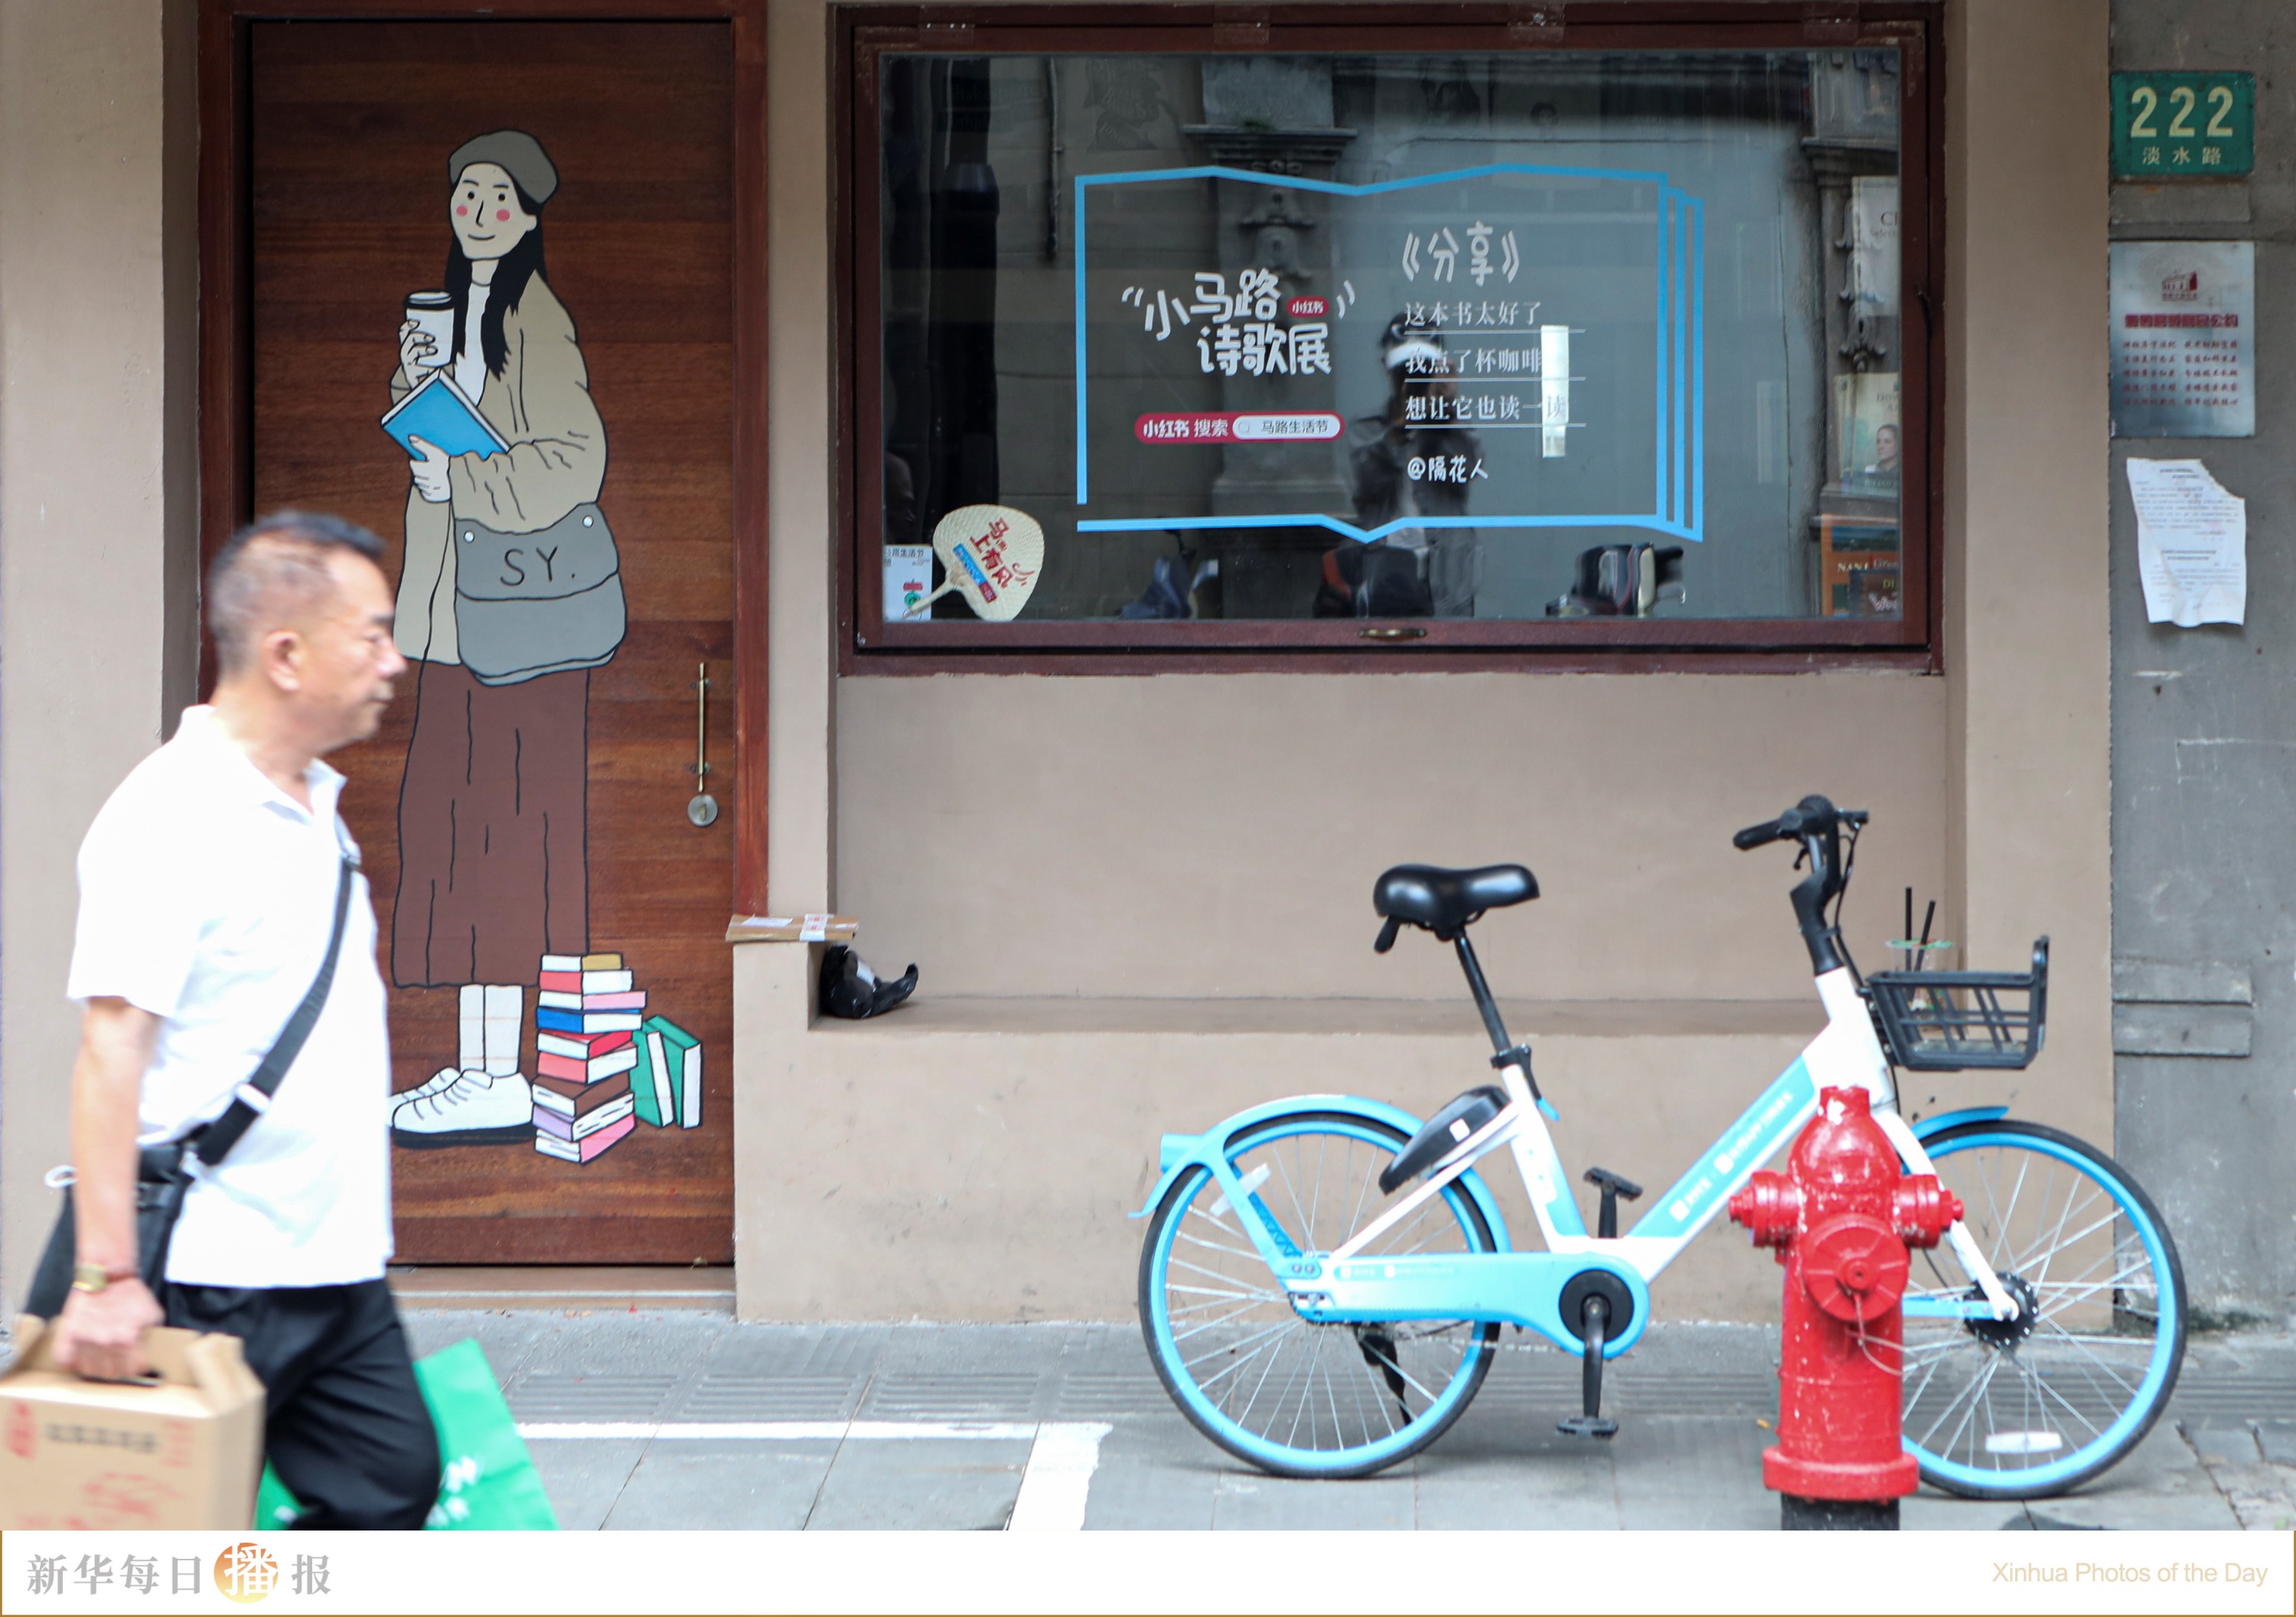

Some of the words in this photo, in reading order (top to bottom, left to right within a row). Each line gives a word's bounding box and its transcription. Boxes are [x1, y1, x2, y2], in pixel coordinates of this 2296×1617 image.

[2130, 85, 2234, 138] 222
[2141, 145, 2222, 165] 淡水路
[1291, 301, 1325, 315] 小红书
[1404, 301, 1542, 327] 这本书太好了
[1196, 321, 1332, 377] 诗歌展
[1404, 347, 1542, 374] 我点了杯咖啡
[1142, 419, 1190, 439] 小红书
[1193, 418, 1229, 438] 搜索
[1261, 419, 1329, 435] 马路生活节
[1407, 455, 1489, 484] @隔花人
